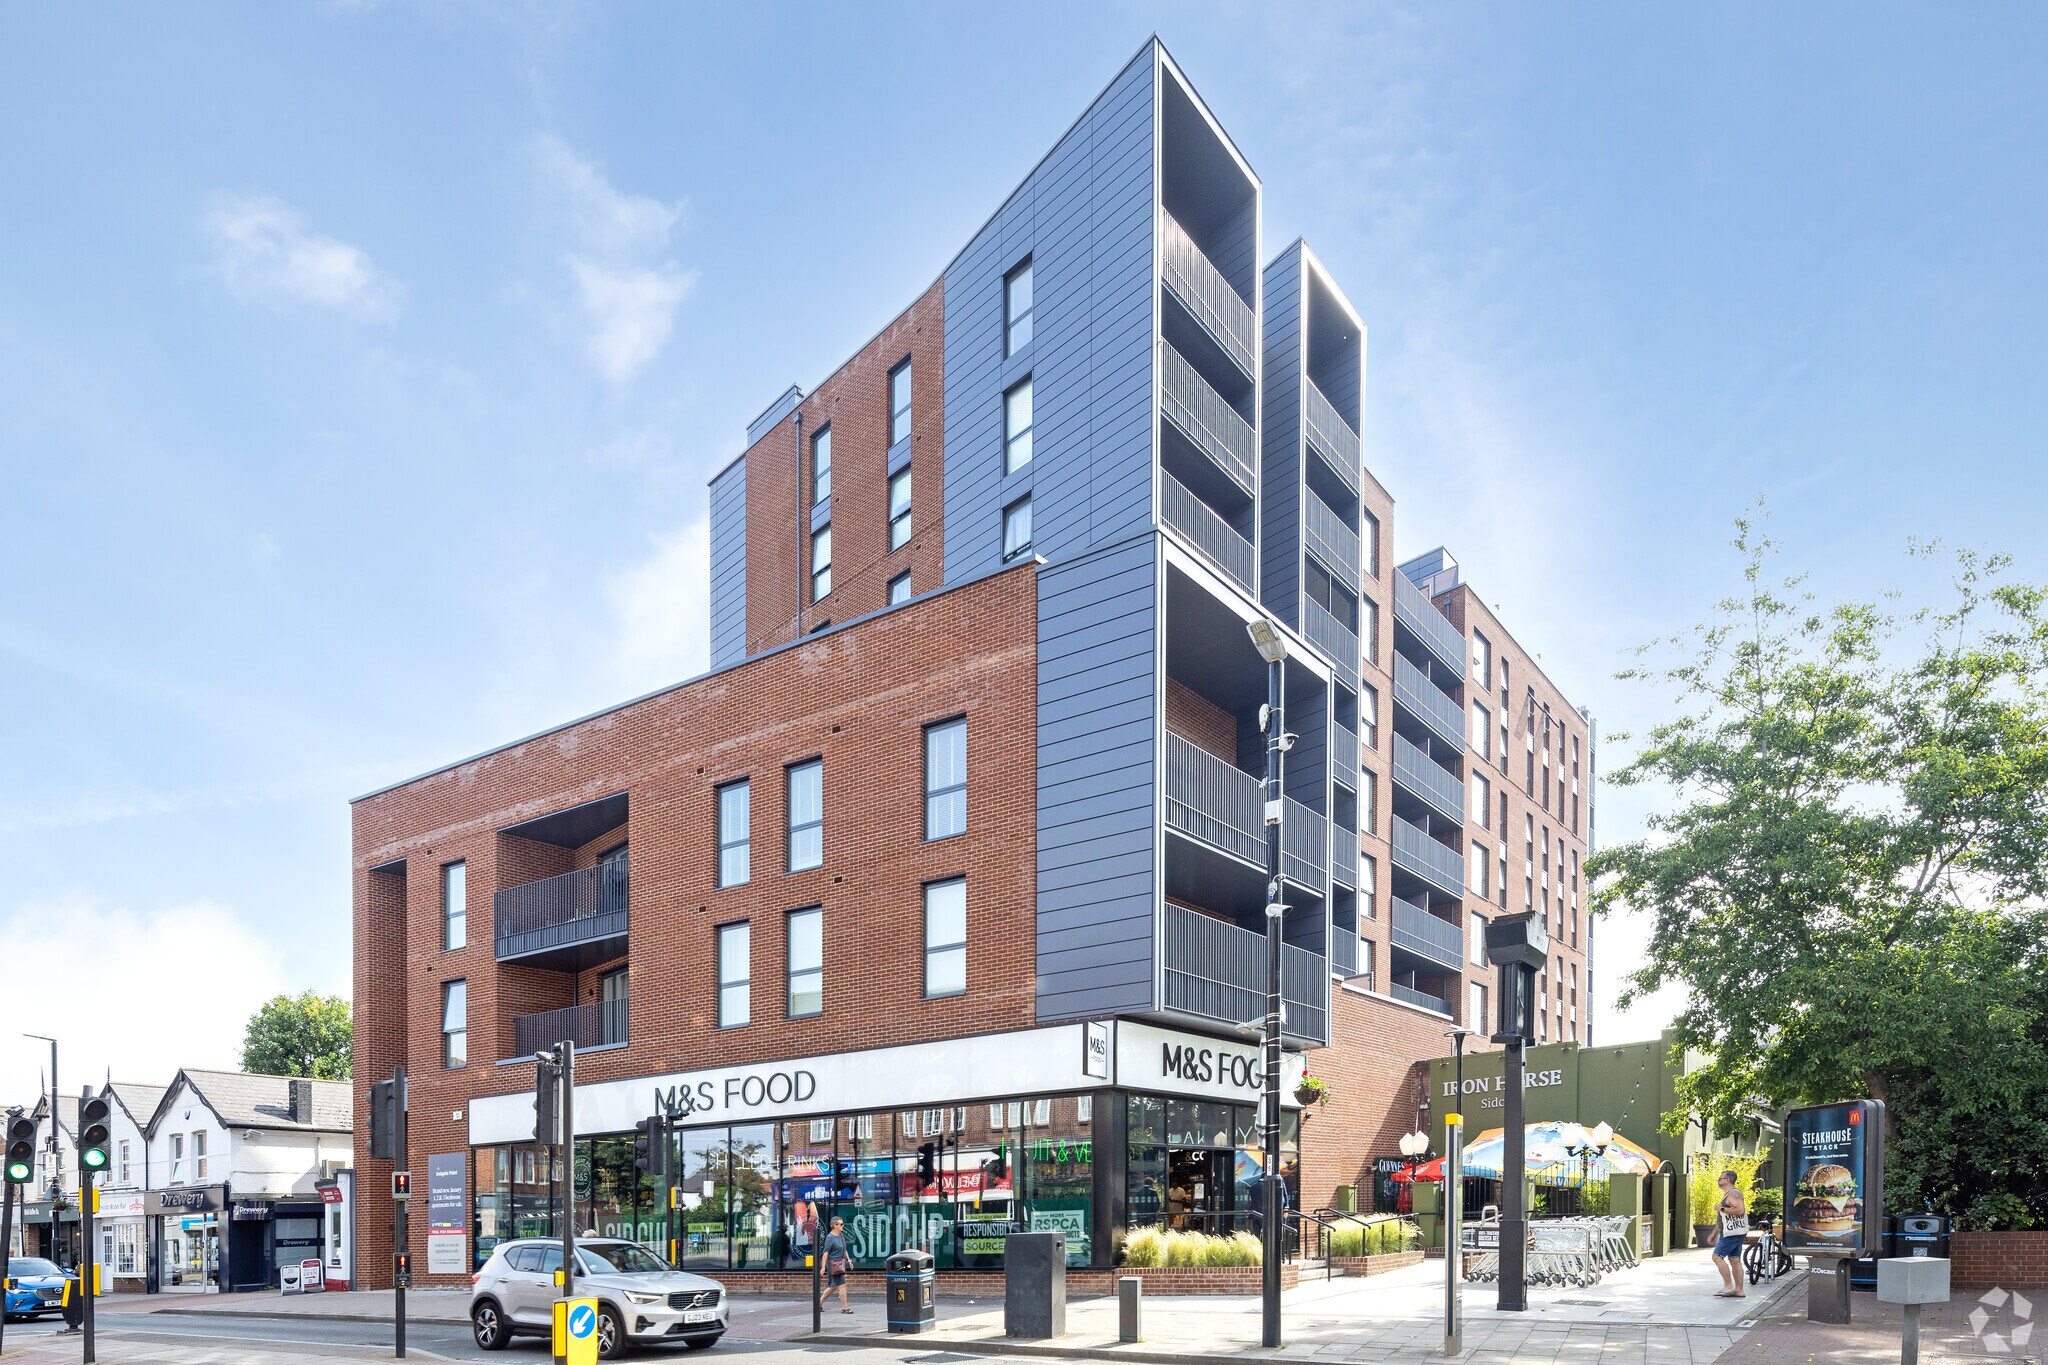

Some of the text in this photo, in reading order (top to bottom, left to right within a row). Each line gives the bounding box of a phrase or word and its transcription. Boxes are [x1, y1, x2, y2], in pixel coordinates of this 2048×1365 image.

[1090, 1036, 1105, 1055] M&S
[1162, 1042, 1262, 1090] M&S FOO
[1442, 1069, 1562, 1097] IRON HRSE
[655, 1070, 816, 1115] M&S FOOD
[1481, 1097, 1505, 1109] Sidc
[1802, 1127, 1852, 1146] STEAKHOUSE
[1057, 1138, 1069, 1163] &
[1074, 1139, 1092, 1163] VE
[1813, 1143, 1839, 1151] STACK
[776, 1152, 831, 1171] RINKS
[1378, 1158, 1405, 1173] GUINNES
[160, 1190, 204, 1209] Drewery
[239, 1205, 268, 1214] Drewery
[963, 1222, 1014, 1237] RESPONSIBLY
[1034, 1217, 1080, 1231] RSPCA
[738, 1231, 752, 1246] NOT
[965, 1241, 1004, 1251] SOURCE
[1810, 1267, 1836, 1275] JCDecaux
